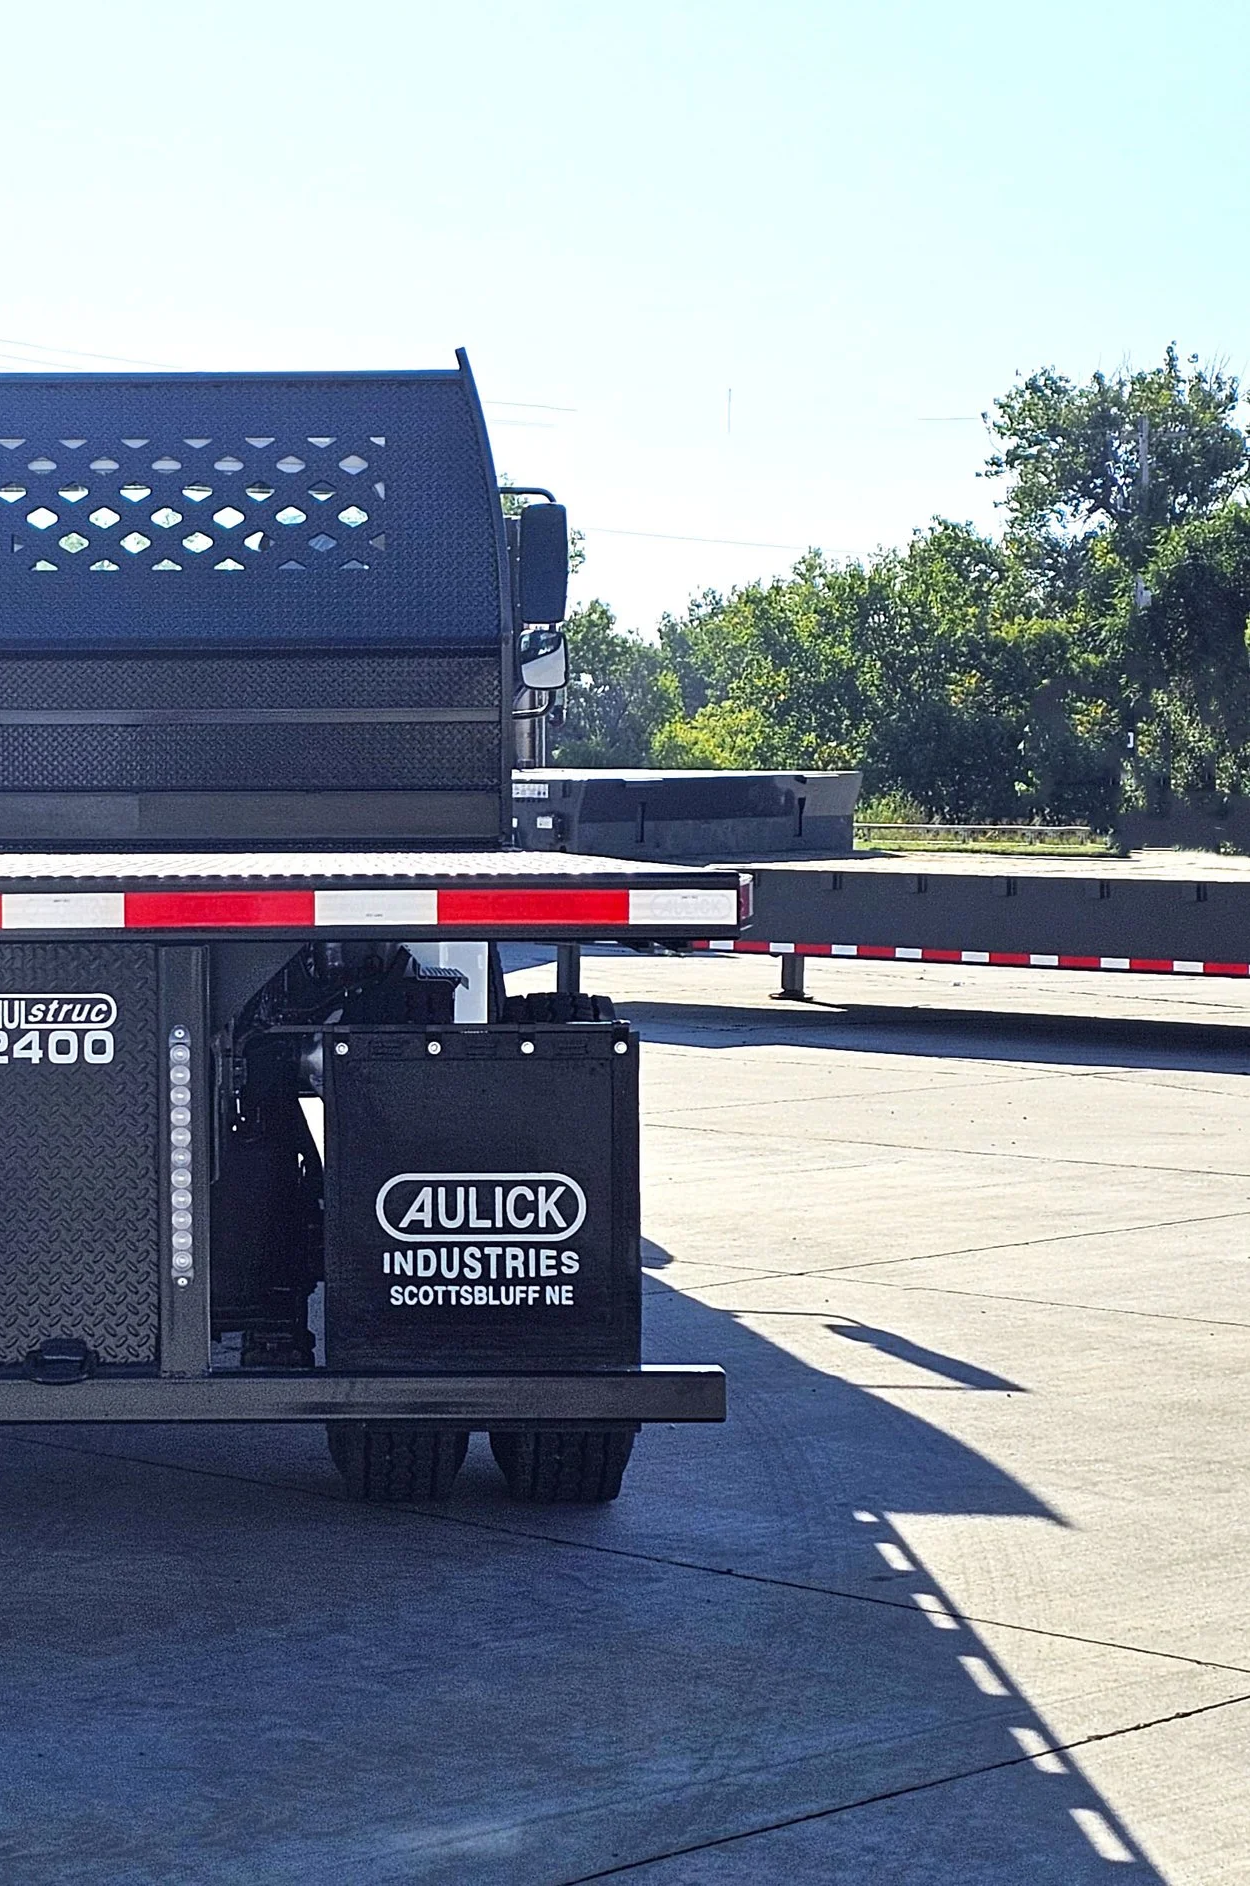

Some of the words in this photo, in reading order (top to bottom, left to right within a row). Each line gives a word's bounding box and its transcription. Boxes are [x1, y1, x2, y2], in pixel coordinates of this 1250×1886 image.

[398, 1185, 568, 1229] AULICK
[383, 1246, 580, 1280] INDUSTRIES
[390, 1285, 541, 1306] SCOTTSBLUFF
[545, 1285, 574, 1305] NE
